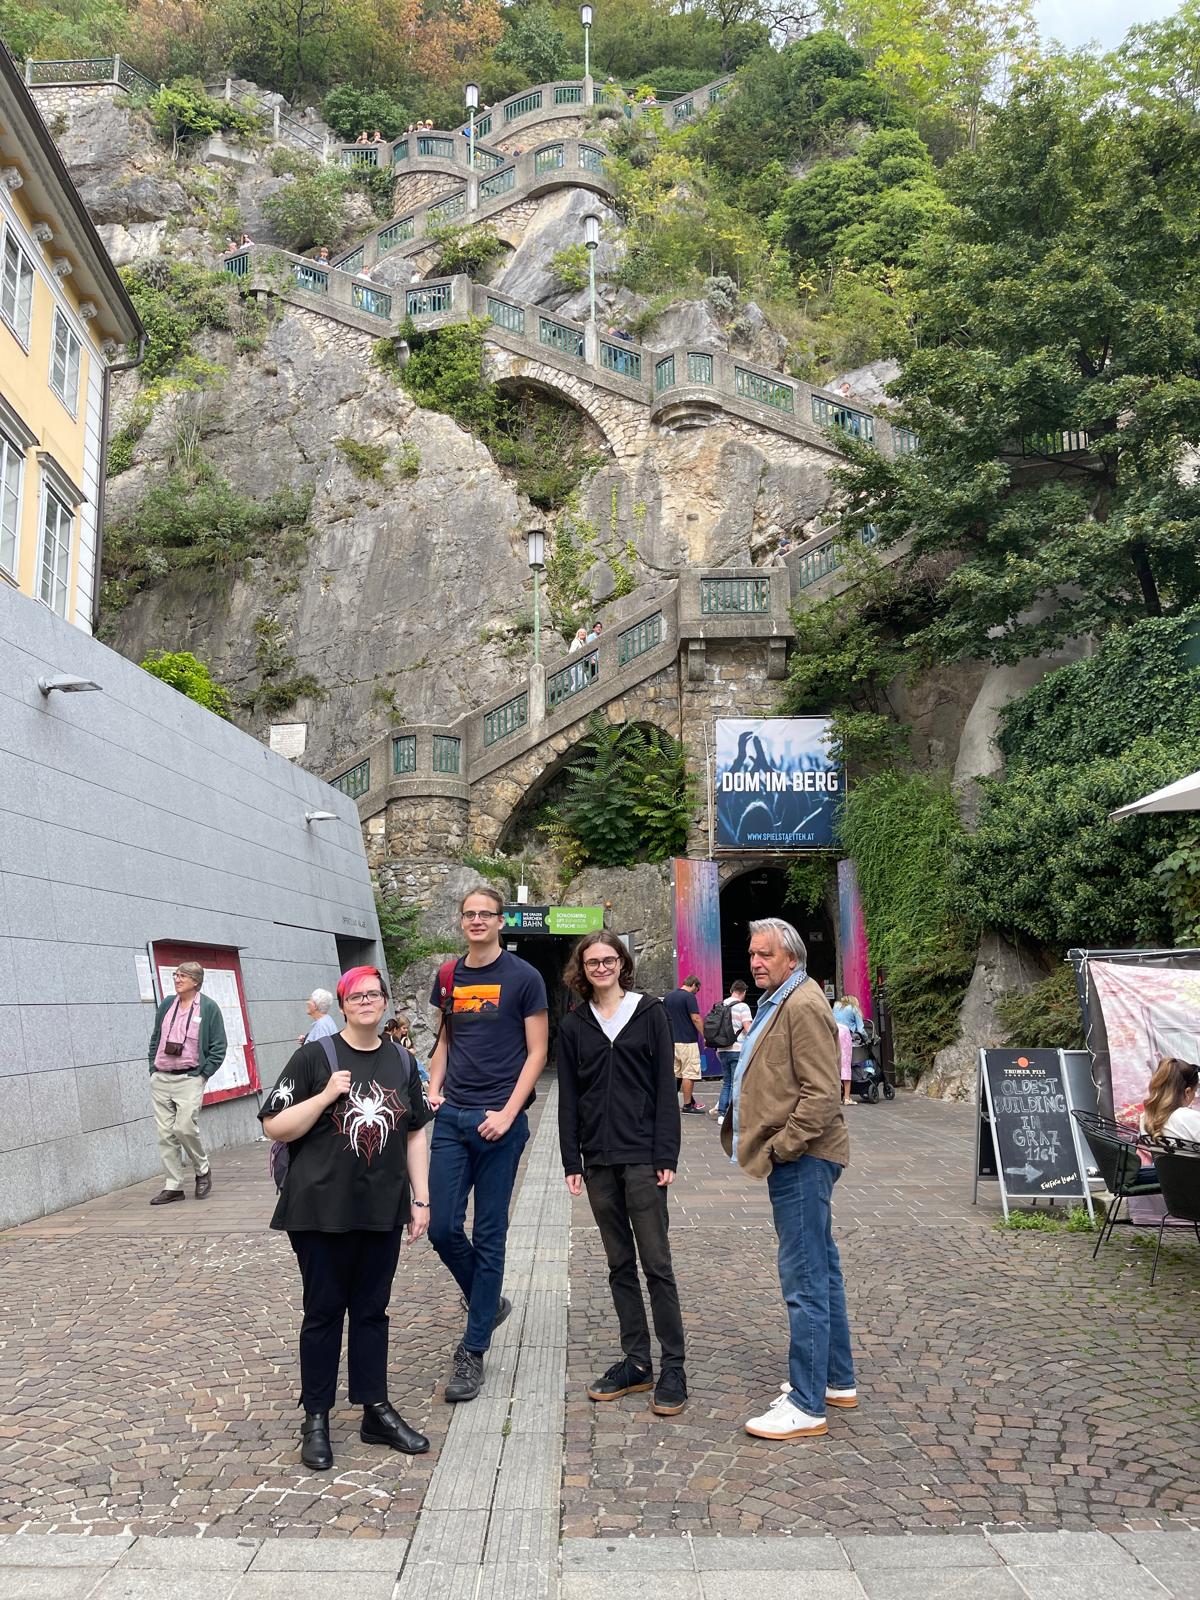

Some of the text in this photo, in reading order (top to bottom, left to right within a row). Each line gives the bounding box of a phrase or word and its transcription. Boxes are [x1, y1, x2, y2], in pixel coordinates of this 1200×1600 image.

[722, 772, 838, 792] DOM IM BERG
[747, 833, 815, 841] WWW.SPIELSTAETTEN.AT
[1001, 1078, 1058, 1096] OLDEST
[994, 1095, 1066, 1113] BUILDING
[1021, 1116, 1040, 1130] IN
[1012, 1129, 1060, 1147] GRAZ
[1025, 1145, 1057, 1163] 1164
